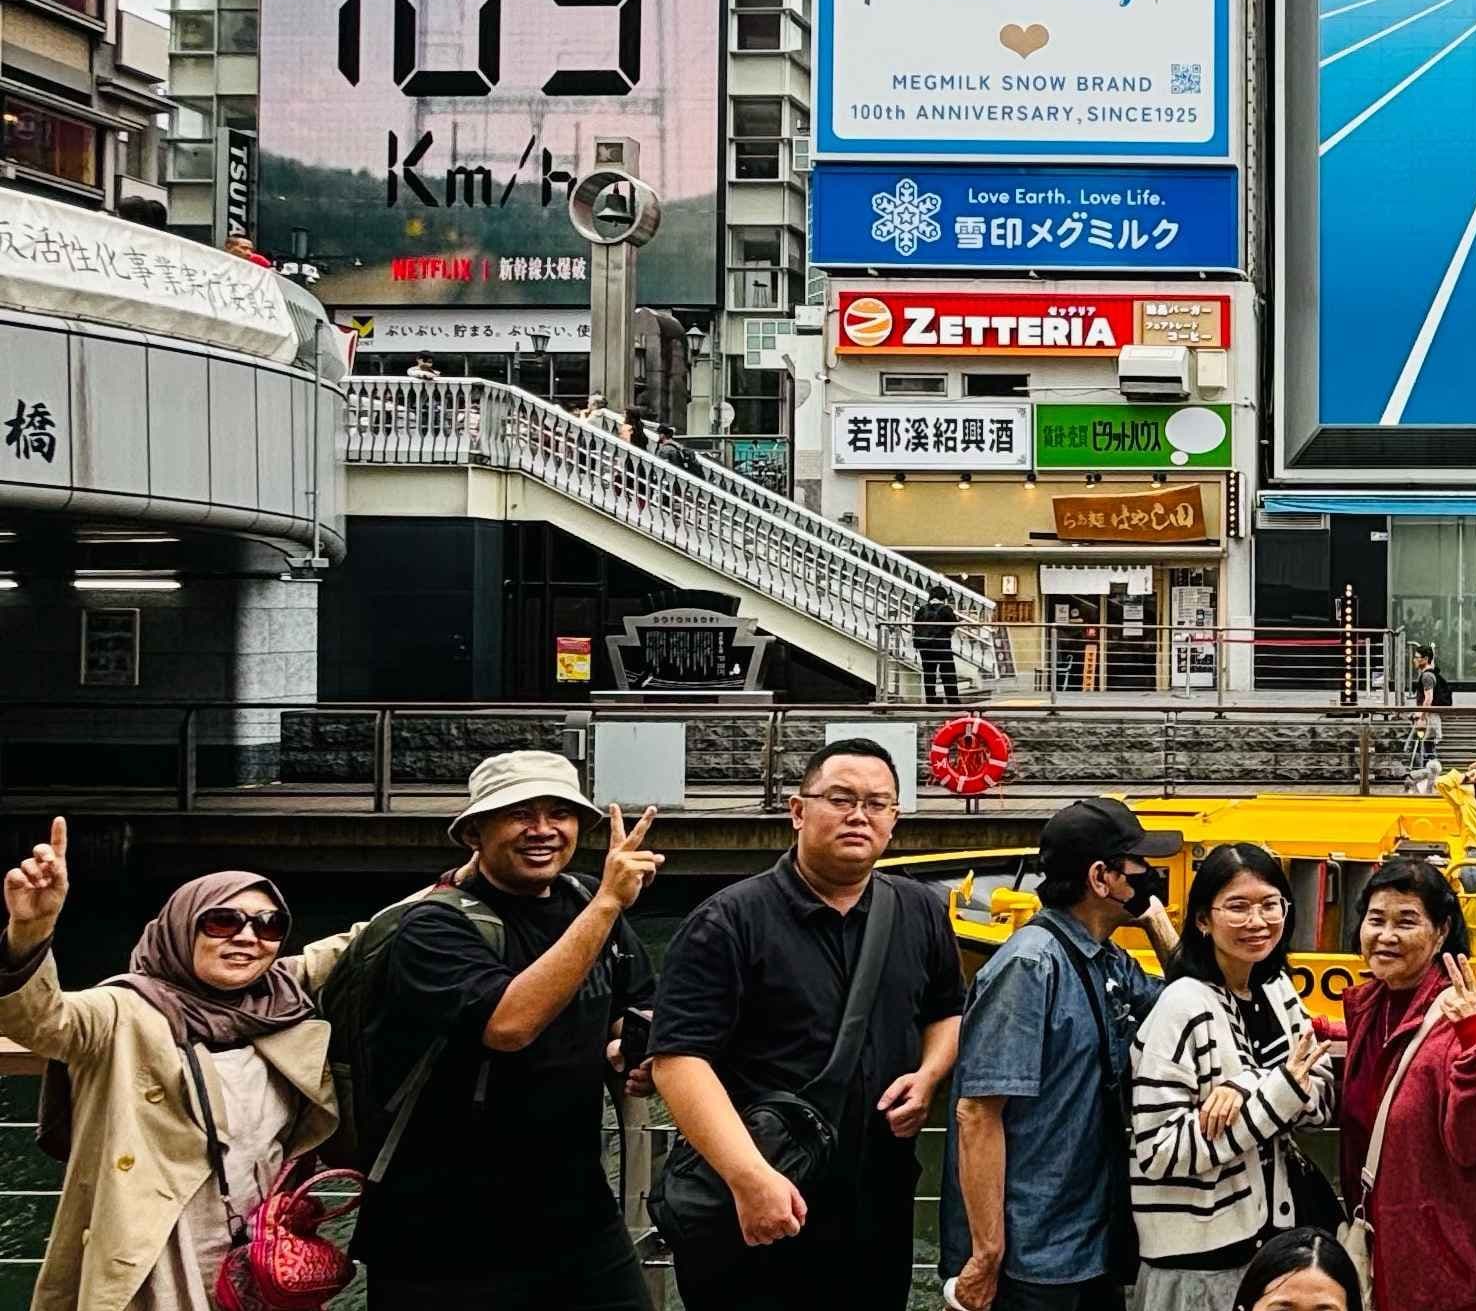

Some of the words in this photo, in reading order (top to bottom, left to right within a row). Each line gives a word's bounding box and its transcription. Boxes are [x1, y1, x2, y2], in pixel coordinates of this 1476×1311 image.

[892, 74, 991, 91] MEGMILK
[1001, 75, 1066, 92] SNOW
[1077, 76, 1153, 93] BRAND
[850, 104, 906, 121] 100th
[968, 188, 1010, 205] Love
[1015, 188, 1073, 205] Earth.
[1080, 189, 1121, 206] Love
[1126, 189, 1167, 206] Life.
[954, 211, 1180, 251] 雪印メグミルク
[391, 256, 471, 281] NETFLIX
[499, 255, 586, 281] 新幹線大爆破
[1048, 305, 1096, 317] ゼッテリア
[902, 306, 1116, 347] ZETTERIA
[5, 399, 56, 463] 橋
[1092, 420, 1163, 452] ピタットハウス
